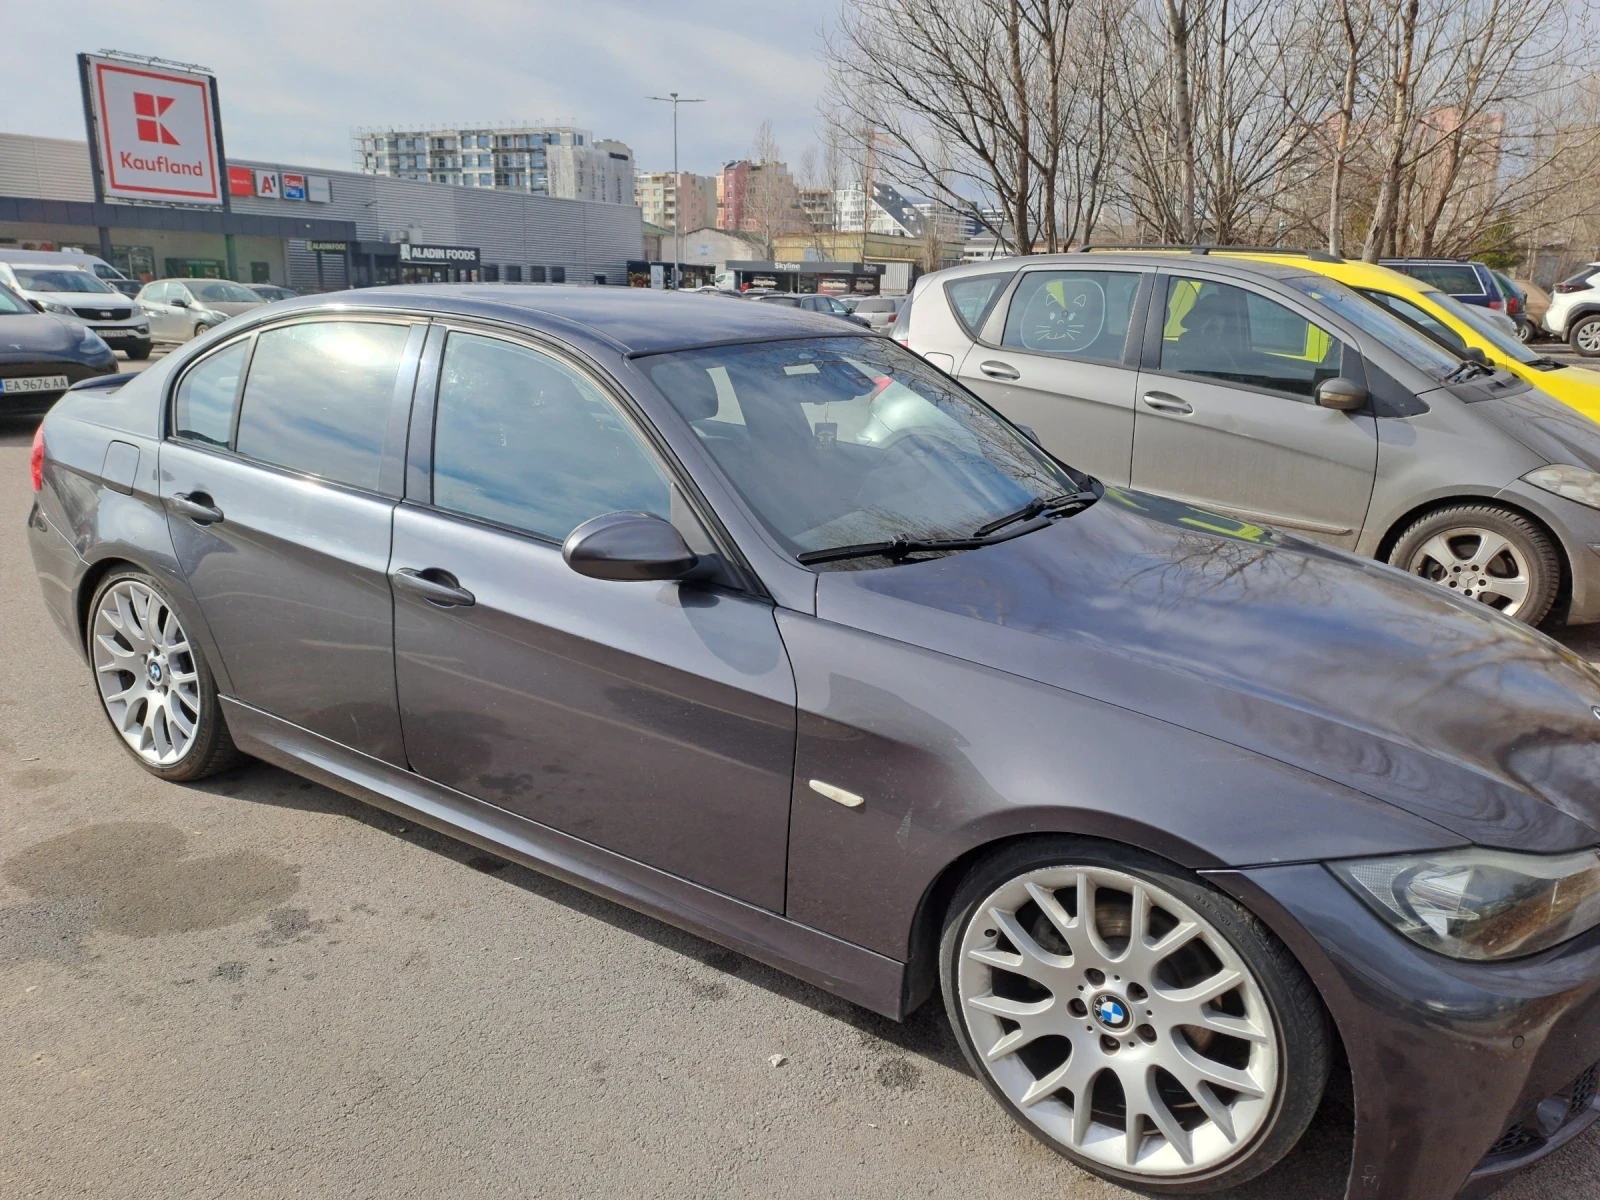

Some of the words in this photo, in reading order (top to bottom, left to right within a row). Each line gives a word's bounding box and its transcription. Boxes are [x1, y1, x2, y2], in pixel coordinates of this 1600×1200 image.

[120, 151, 203, 177] Kaufland
[261, 174, 277, 194] A1
[411, 247, 445, 259] ALADIN
[446, 249, 476, 261] FOODS
[774, 262, 801, 271] Skyline
[5, 380, 21, 391] EA
[23, 378, 51, 390] 9676
[53, 377, 67, 388] AA
